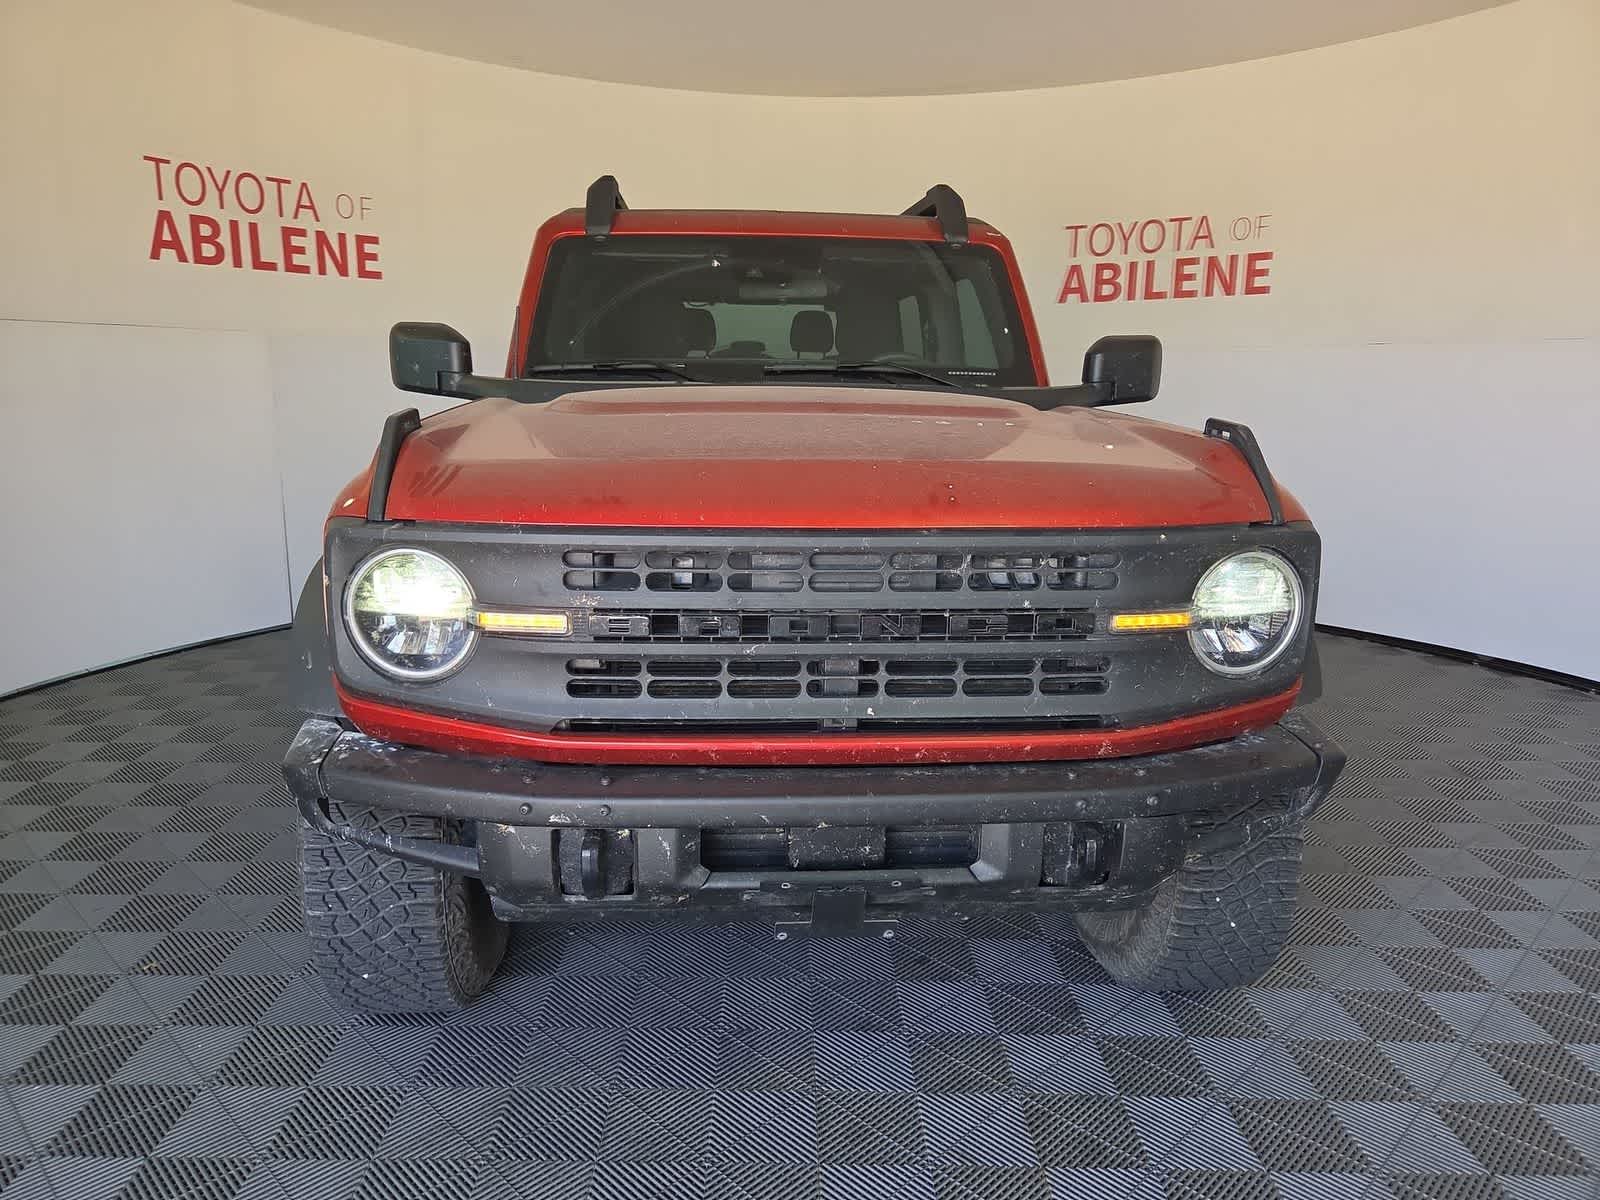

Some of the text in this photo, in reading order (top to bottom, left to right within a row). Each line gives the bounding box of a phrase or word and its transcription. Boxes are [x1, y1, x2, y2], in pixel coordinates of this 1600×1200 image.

[143, 155, 373, 222] TOYOTA OF
[149, 209, 383, 280] ABILENE
[1063, 214, 1273, 258] TOYOTA OF
[1057, 251, 1273, 304] ABILENE
[588, 613, 1096, 639] BRONCO
